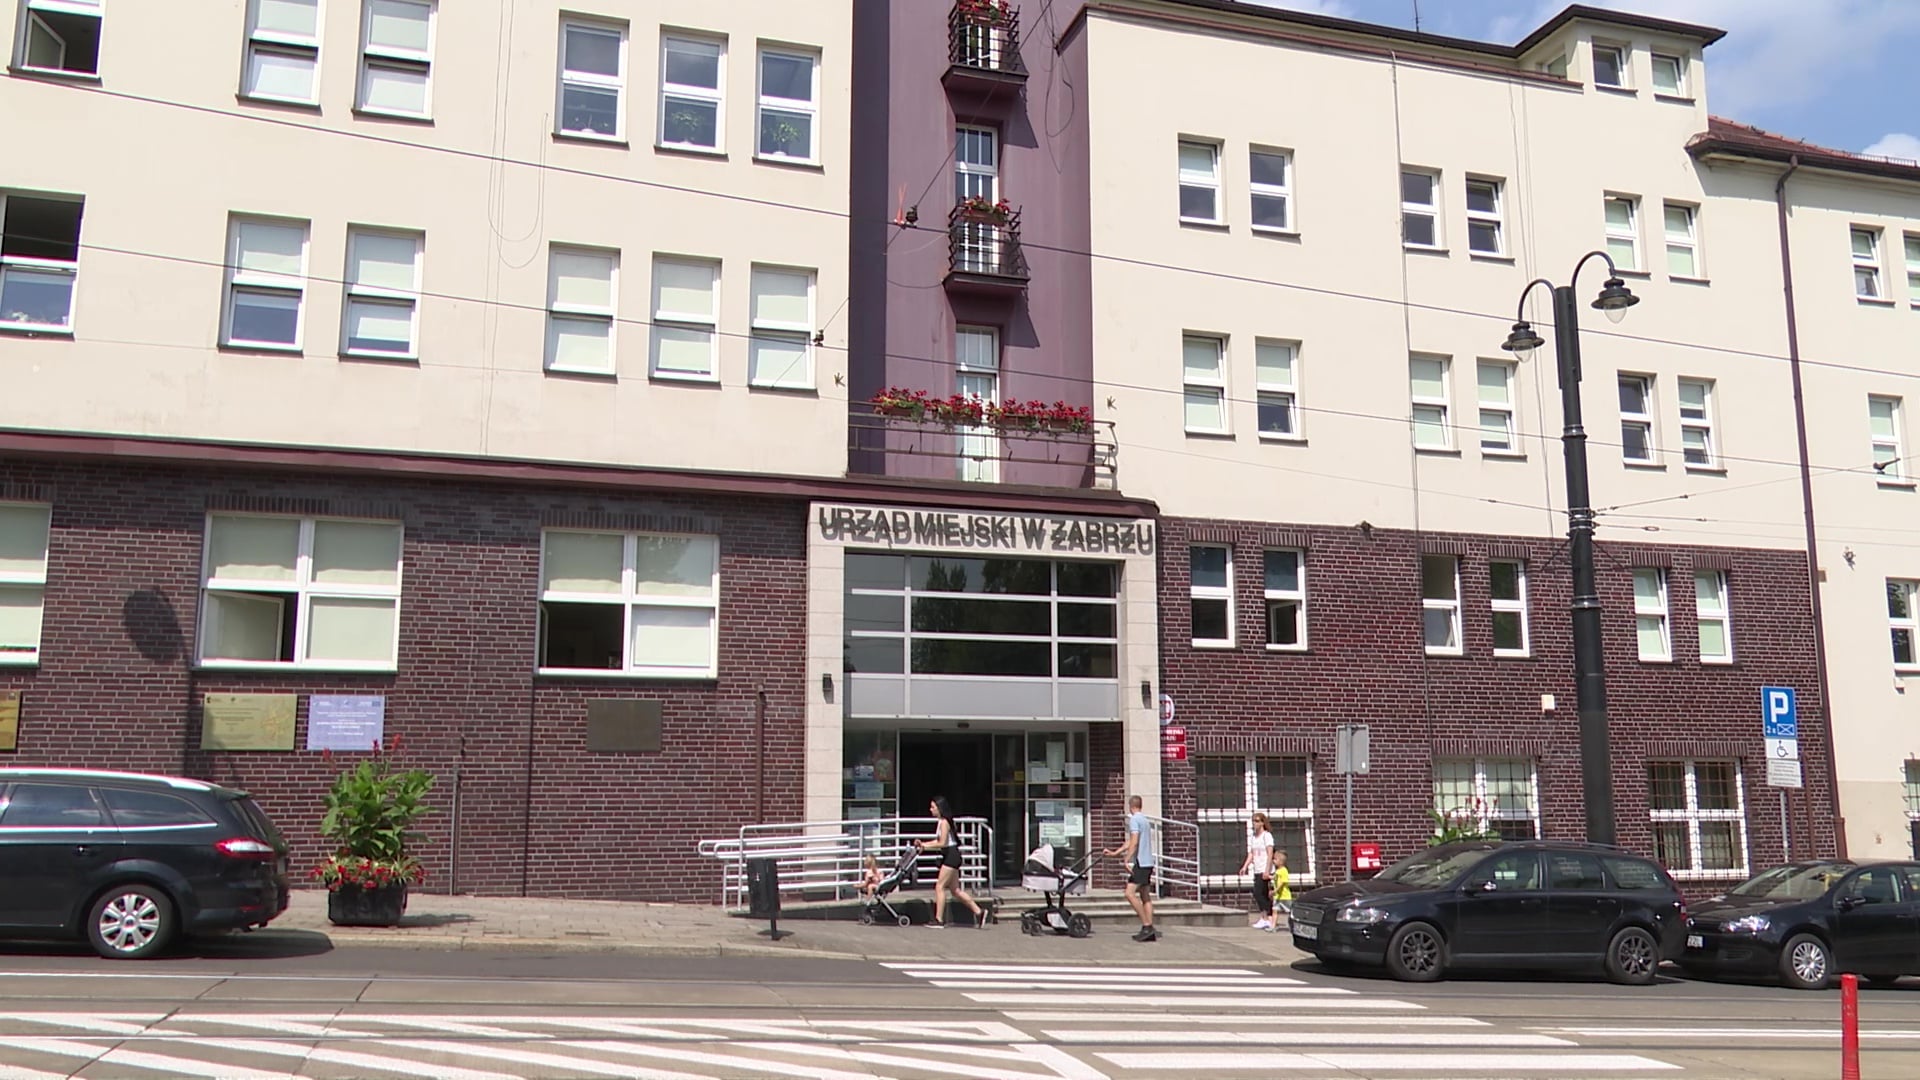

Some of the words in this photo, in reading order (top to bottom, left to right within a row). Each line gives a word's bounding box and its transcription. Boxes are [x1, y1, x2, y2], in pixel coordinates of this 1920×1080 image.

[914, 512, 1016, 546] MIEJSKI
[1021, 518, 1046, 547] W
[1050, 520, 1153, 551] ZABRZU
[1770, 691, 1788, 722] P
